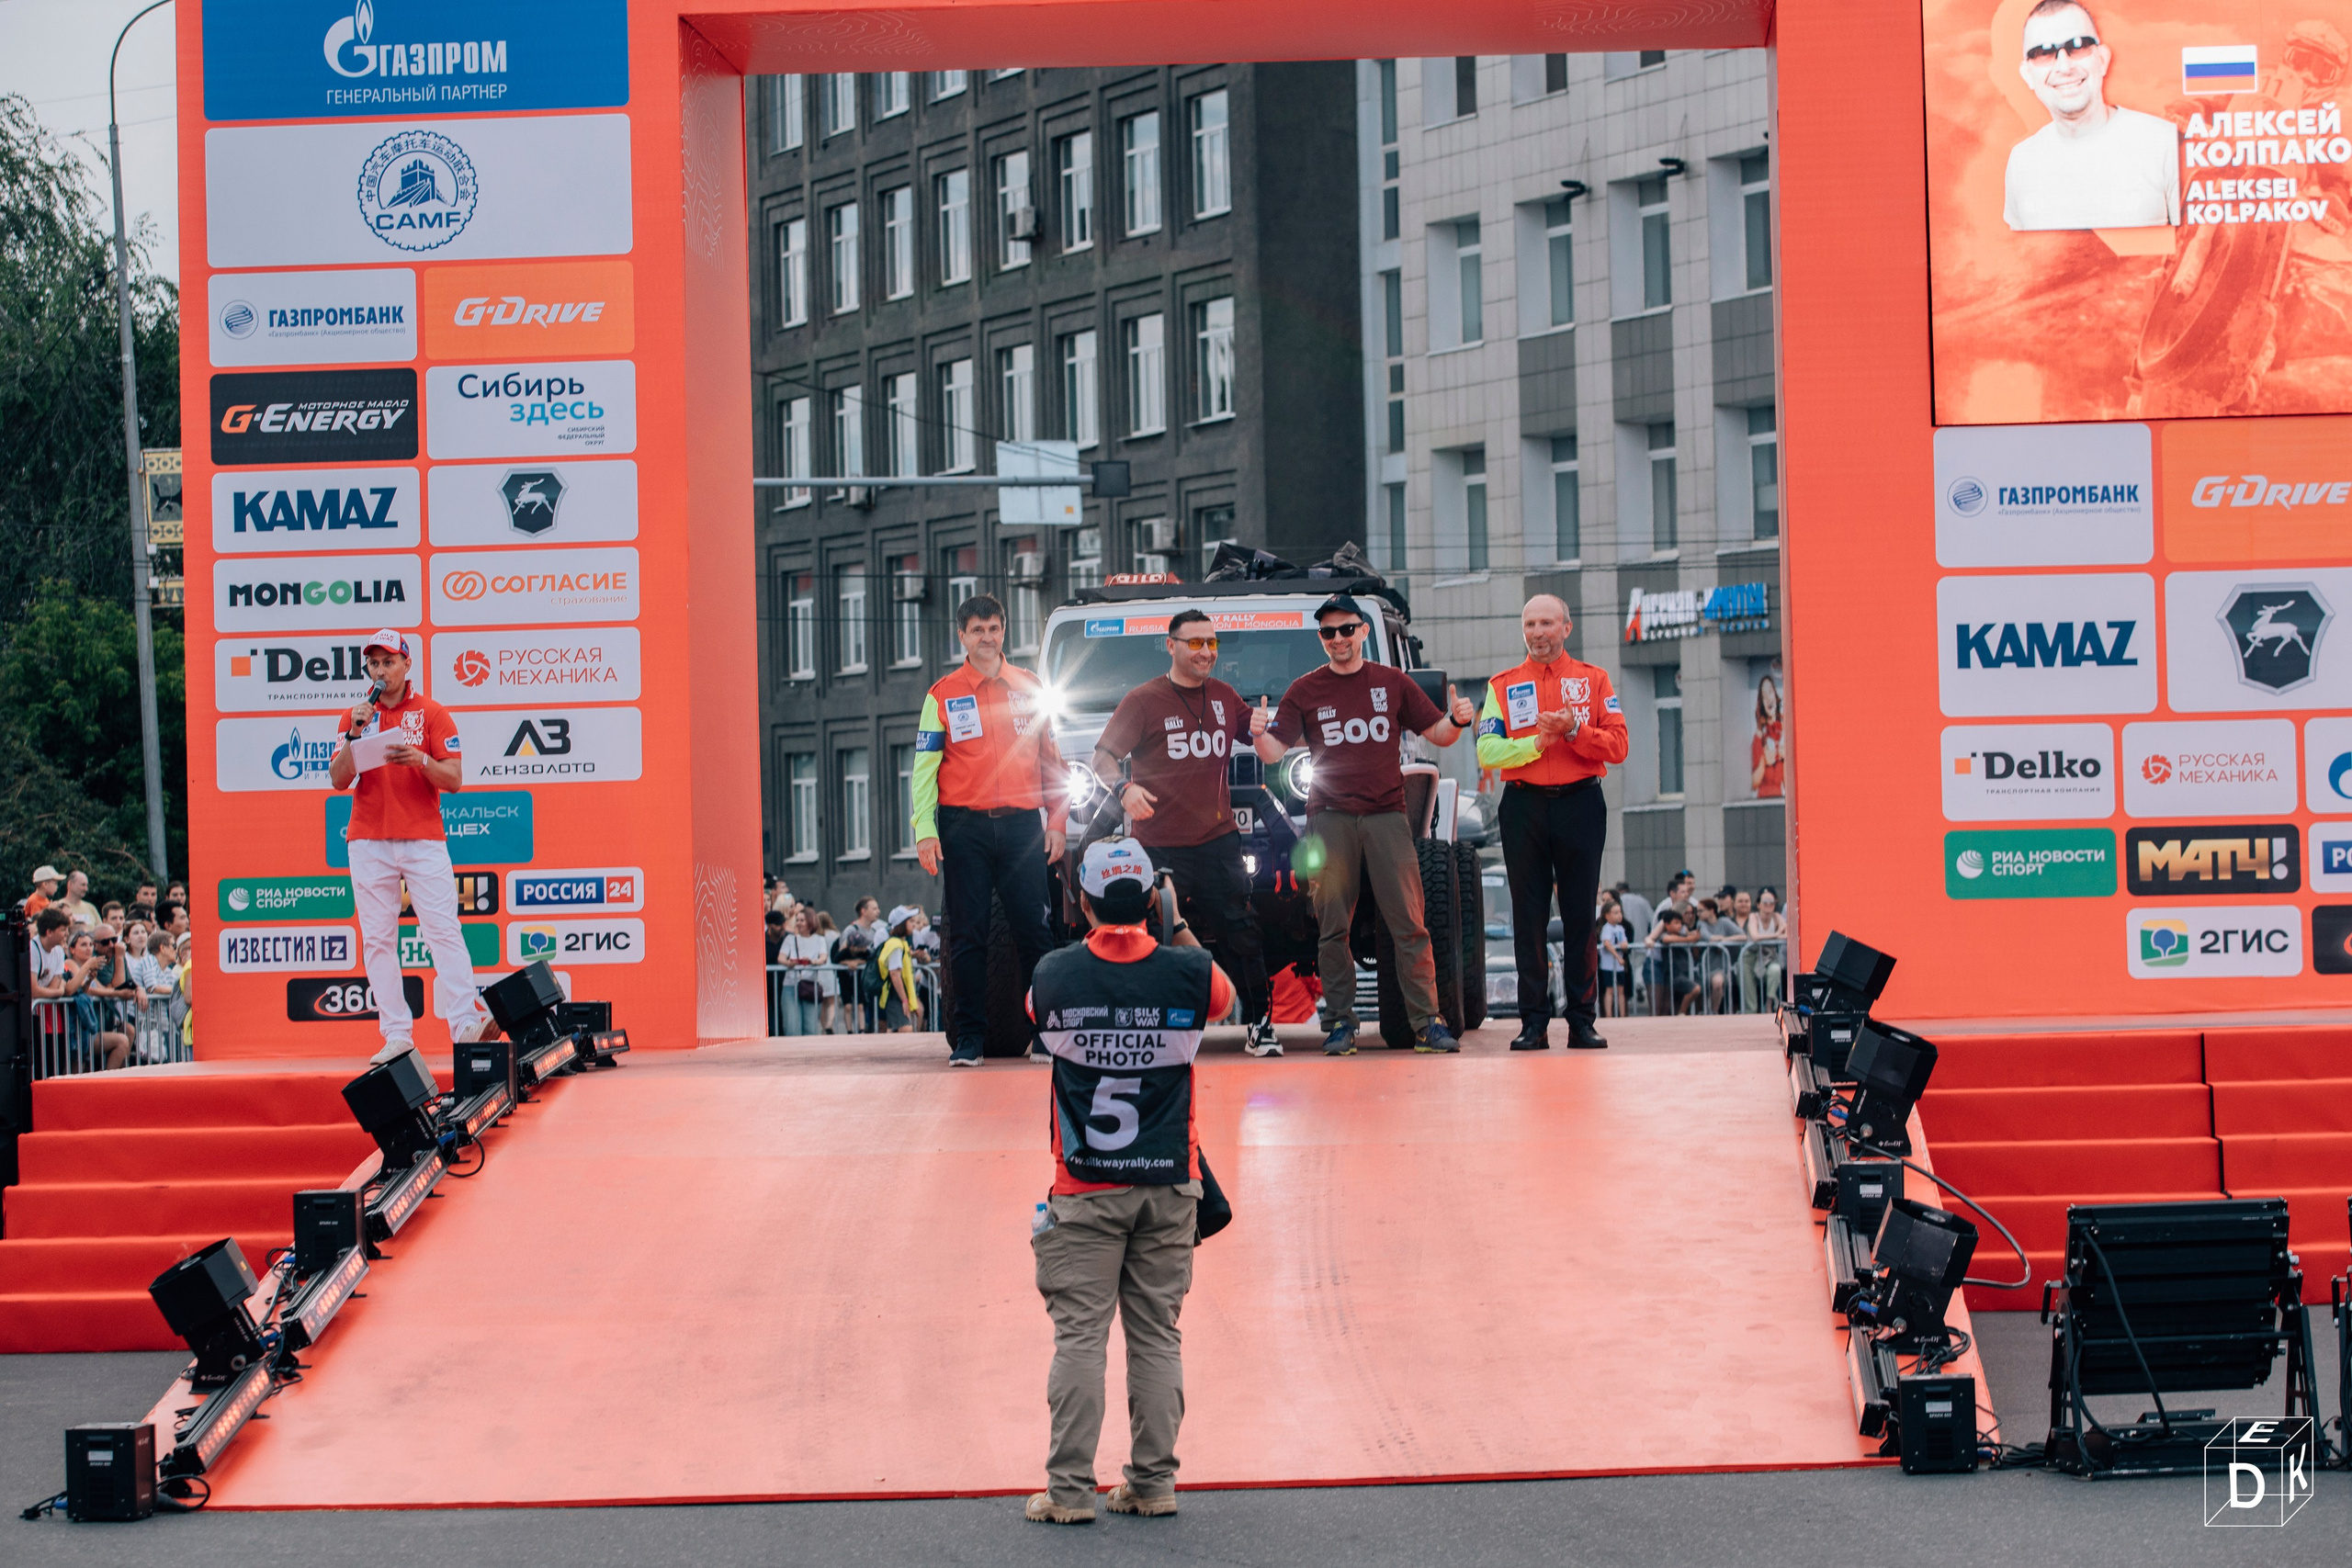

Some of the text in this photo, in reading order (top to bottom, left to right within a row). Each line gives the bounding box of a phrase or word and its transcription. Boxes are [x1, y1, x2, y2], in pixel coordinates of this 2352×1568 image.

[379, 40, 507, 77] ГАЗПРОМ
[326, 84, 507, 105] ГЕНЕРАЛЬНЫЙ ПАРТНЕР
[2184, 102, 2341, 140] АЛЕКСЕЙ
[2187, 136, 2352, 167] КОЛПАКО
[2187, 178, 2296, 202] ALEKSEI
[375, 211, 461, 230] CAMF
[2188, 200, 2328, 224] KOLPAKOV
[268, 306, 404, 327] ГАЗПРОМБАНК
[458, 372, 584, 402] Сибирь
[298, 399, 410, 411] МОТОРНОЕ МАСЛО
[510, 400, 605, 426] здесь
[558, 432, 605, 440] ФЕДЕРАЛЬНЫЙ
[568, 424, 605, 433] СИБИРСКИЙ
[1998, 483, 2139, 505] ГАЗПРОМБАНК
[233, 487, 399, 533] KAMAZ
[491, 571, 628, 595] СОГЛАСИЕ
[230, 579, 406, 607] MONGOLIA
[551, 594, 628, 606] страхование
[1223, 614, 1257, 622] RALLY
[1244, 619, 1299, 628] MONGOLIA
[1128, 625, 1165, 633] RUSSIA
[1955, 619, 2138, 669] KAMAZ
[265, 646, 373, 683] Delk
[500, 647, 603, 665] РУССКАЯ
[500, 667, 617, 685] МЕХАНИКА
[1572, 706, 1589, 716] ILK
[1321, 715, 1390, 747] 500
[304, 742, 336, 759] ГАЗП
[1167, 729, 1226, 761] 500
[481, 762, 595, 775] ЛЕНЗОЛОТО
[1983, 750, 2101, 780] Delko
[2178, 753, 2266, 768] РУССКАЯ
[2178, 768, 2278, 784] МЕХАНИКА
[1992, 849, 2106, 863] РИА НОВОСТИ
[2137, 837, 2288, 882] МАТЧ!
[1992, 862, 2045, 876] СПОРТ
[255, 886, 345, 899] РИА НОВОСТИ
[522, 880, 632, 901] РОССИЯ 24
[255, 897, 298, 909] СПОРТ
[227, 937, 316, 964] ИЗВЕСТИЯ
[564, 931, 630, 952] 2ГИС
[2199, 929, 2290, 953] 2ГИС
[1062, 1005, 1108, 1019] МОСКОВСКИЙ
[1135, 1007, 1160, 1017] SILK
[1062, 1018, 1084, 1029] СПОРТ
[1135, 1017, 1160, 1027] WAY
[1073, 1033, 1167, 1048] OFFICIAL
[1086, 1050, 1155, 1066] PHOTO
[1085, 1076, 1142, 1152] 5
